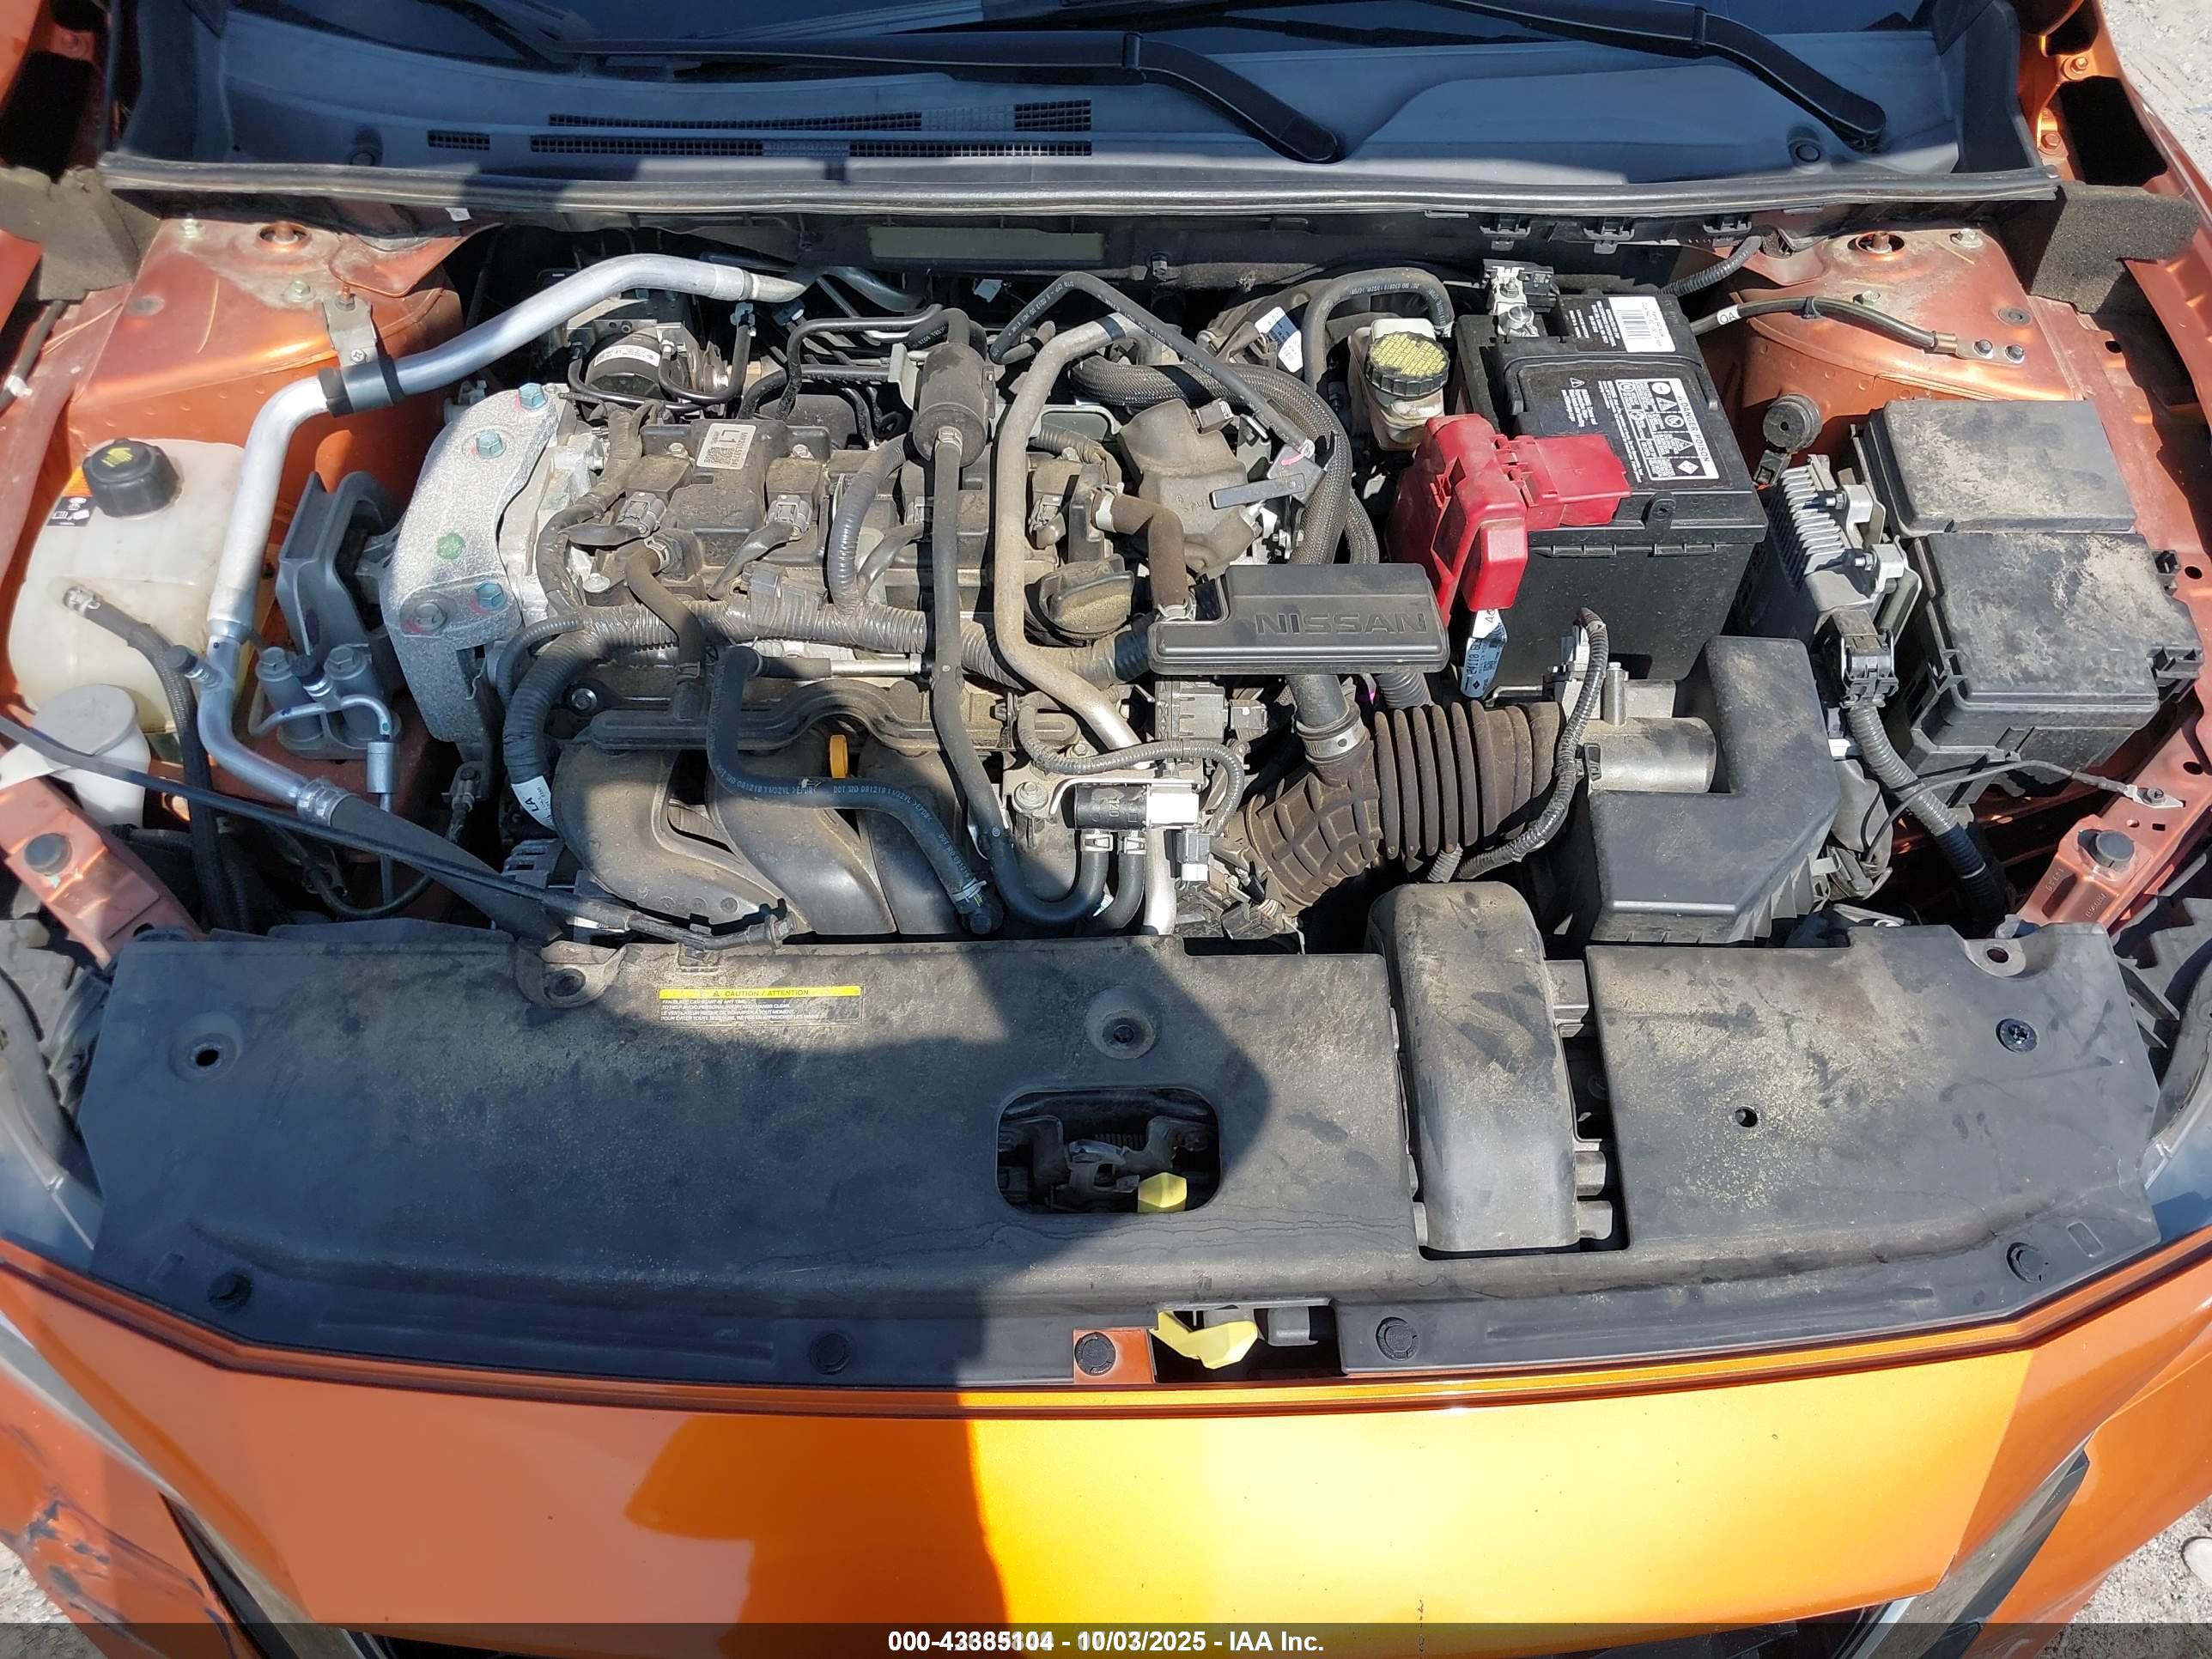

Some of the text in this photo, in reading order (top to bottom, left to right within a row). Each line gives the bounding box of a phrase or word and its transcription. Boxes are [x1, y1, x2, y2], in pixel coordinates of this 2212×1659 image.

[1255, 612, 1430, 635] NISSAN
[525, 797, 539, 812] LA
[1108, 798, 1121, 817] 120
